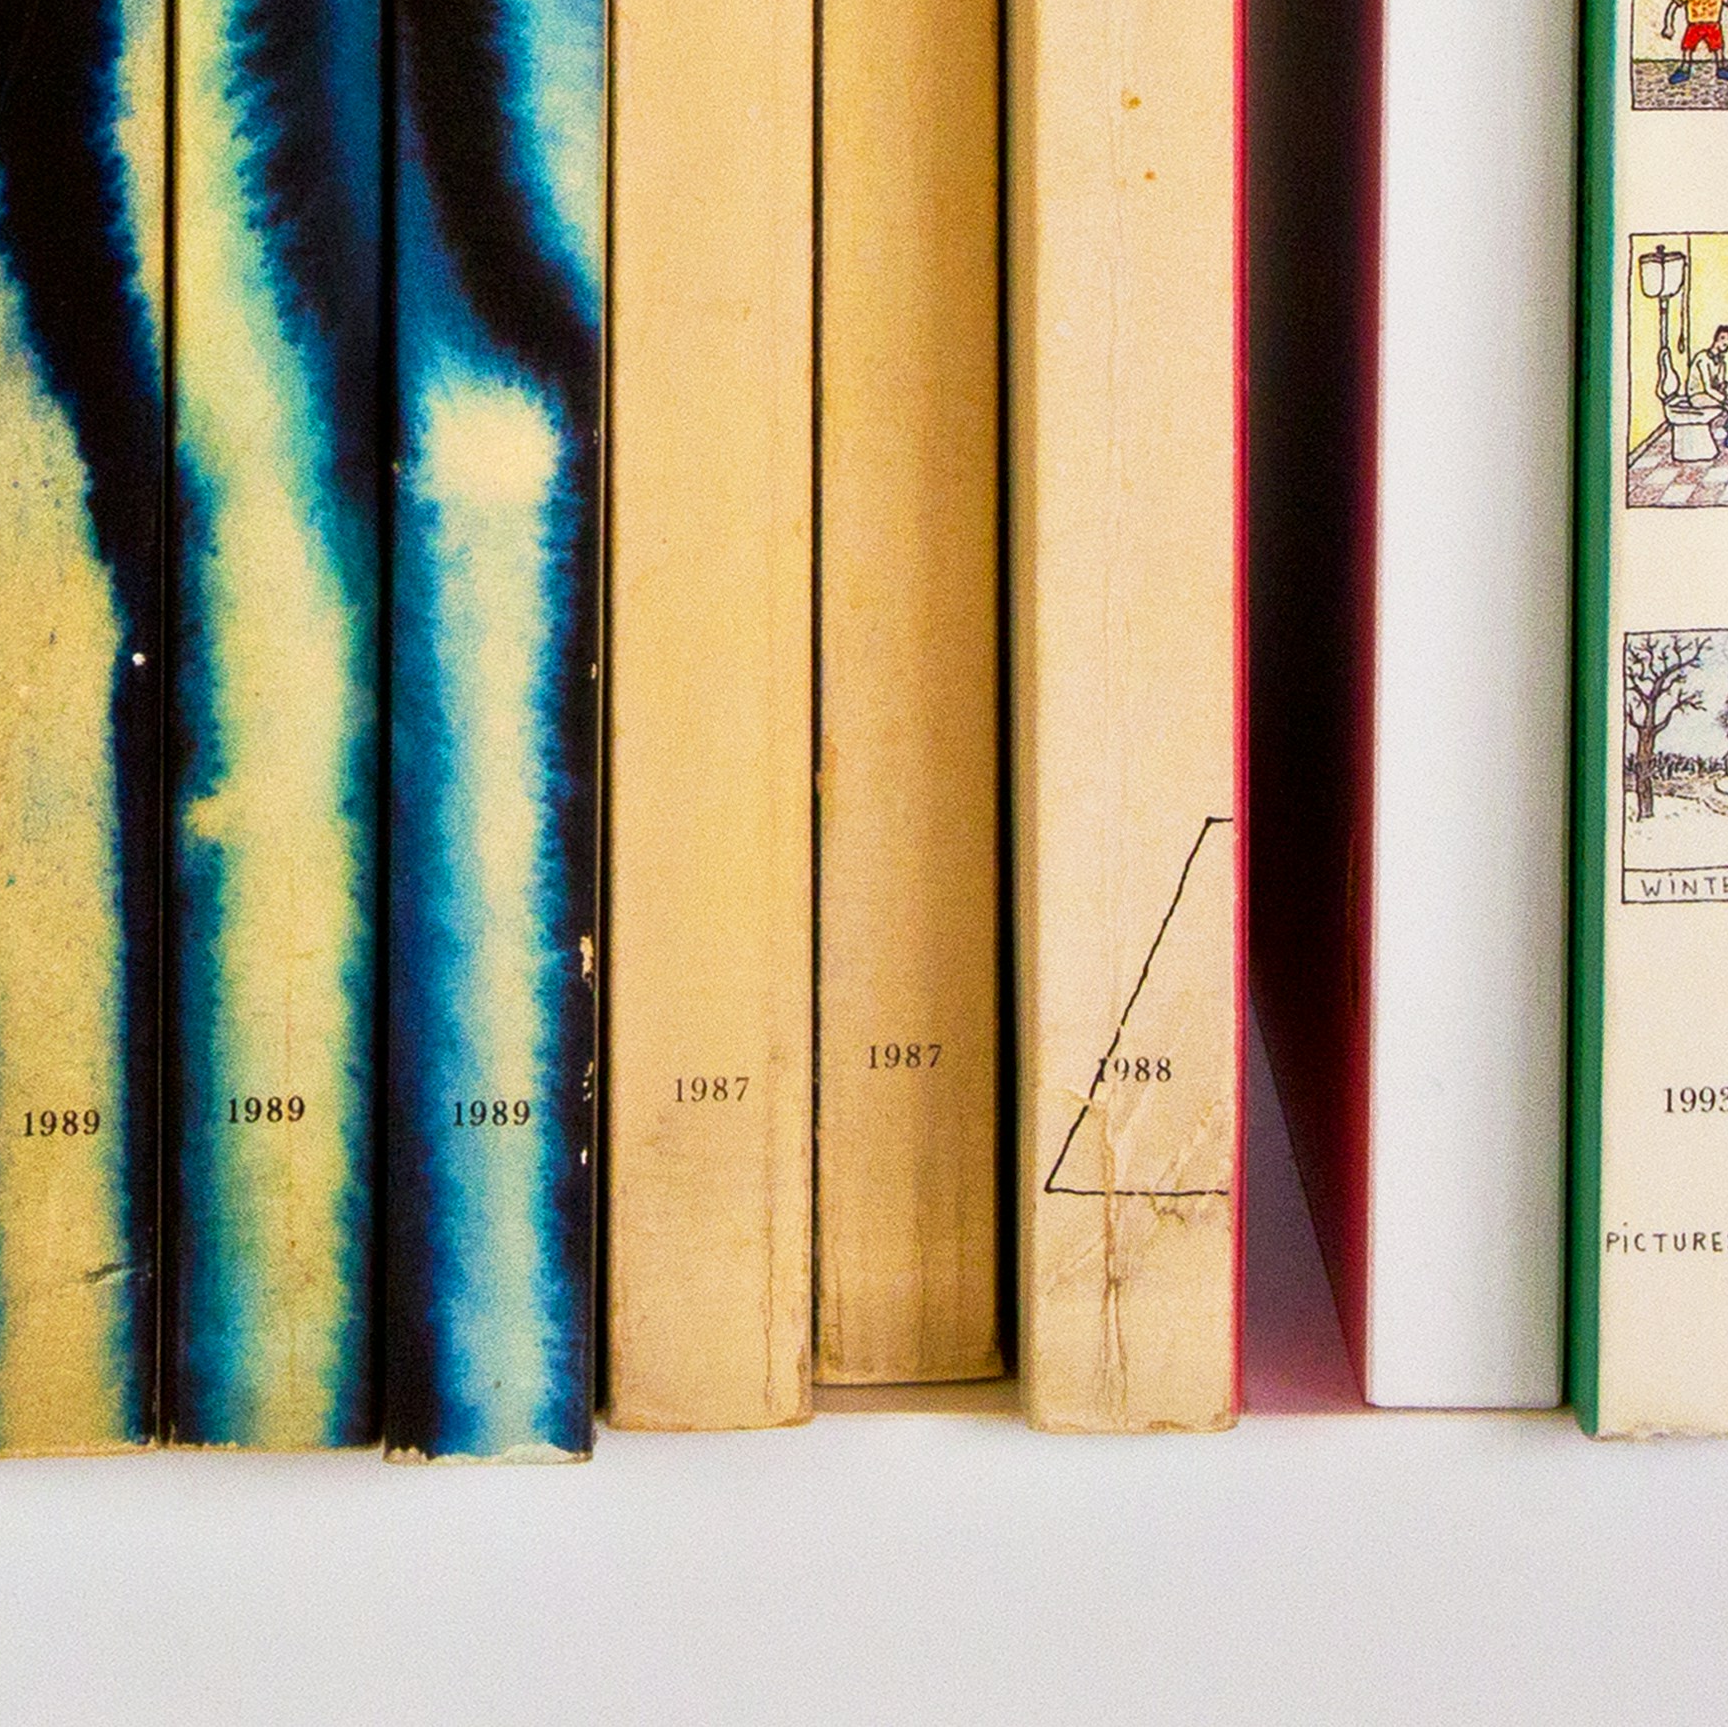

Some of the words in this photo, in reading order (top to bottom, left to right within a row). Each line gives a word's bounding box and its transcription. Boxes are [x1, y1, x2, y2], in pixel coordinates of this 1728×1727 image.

[869, 1043, 942, 1070] 1987
[1095, 1056, 1172, 1085] 1988
[676, 1076, 750, 1103] 1987
[24, 1109, 101, 1138] 1989
[230, 1095, 306, 1124] 1989
[454, 1100, 531, 1127] 1989
